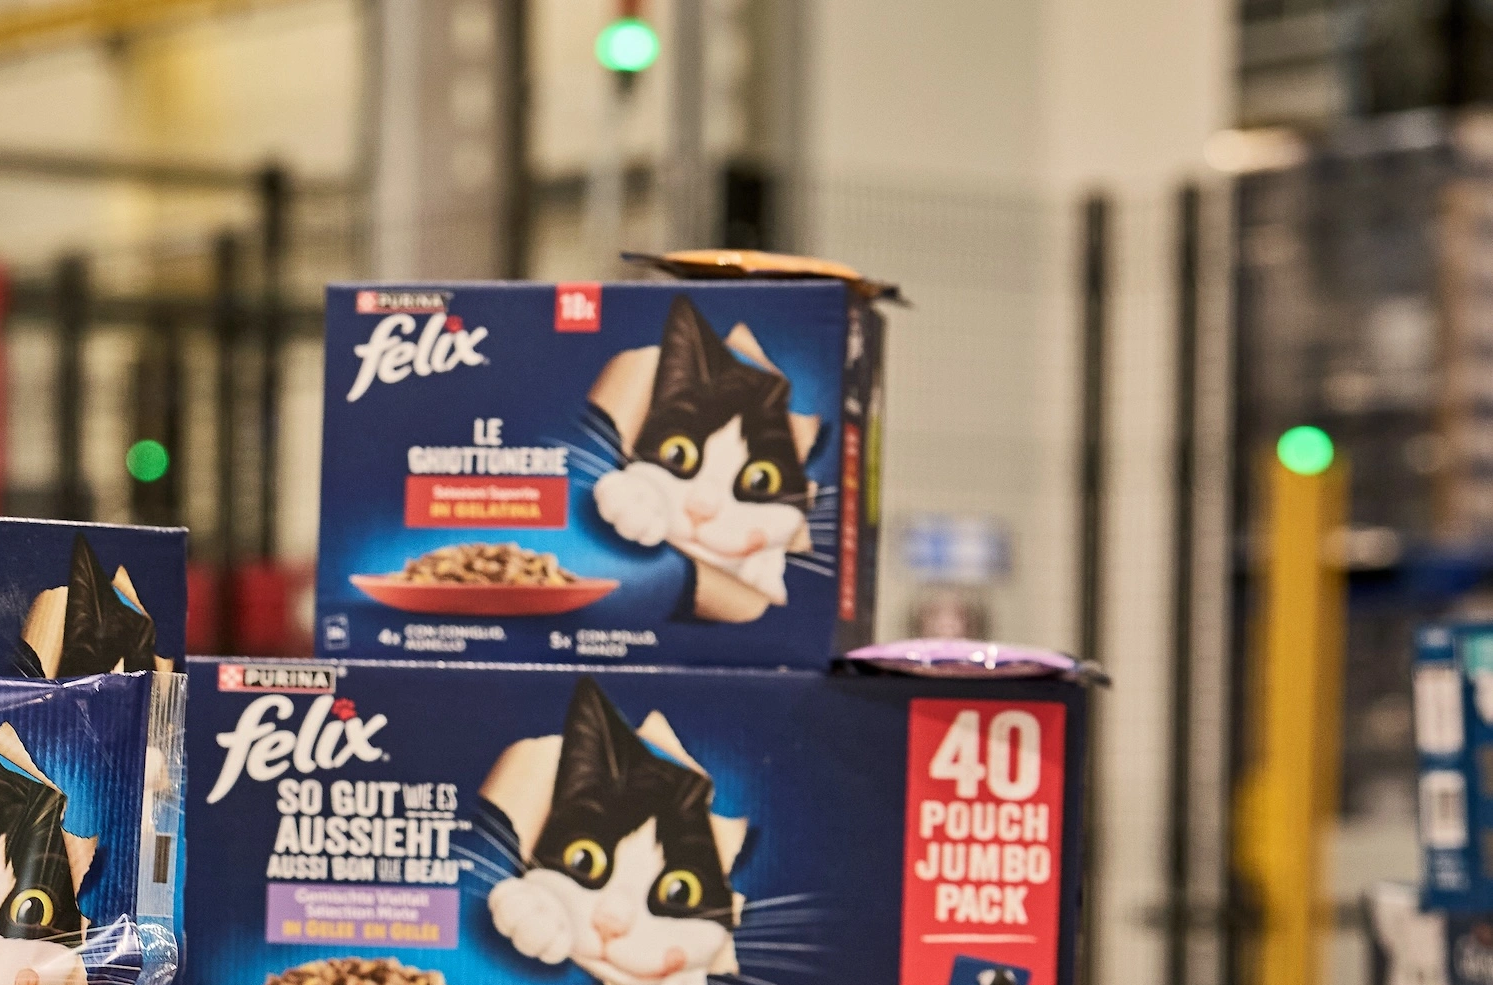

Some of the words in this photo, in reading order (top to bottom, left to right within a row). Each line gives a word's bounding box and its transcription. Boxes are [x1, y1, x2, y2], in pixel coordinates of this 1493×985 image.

[346, 312, 489, 402] felix
[473, 417, 504, 446] LE
[408, 446, 569, 475] GHIOTTONERIE
[244, 669, 329, 688] PURINA
[207, 694, 388, 804] felix
[929, 709, 1041, 800] 40
[277, 779, 323, 815] SO
[331, 780, 400, 817] GUT
[274, 815, 458, 858] AUSSIEHT
[920, 800, 1048, 842] POUCH
[267, 854, 327, 879] AUSSI
[331, 857, 375, 881] BON
[405, 860, 458, 884] BEAU
[915, 842, 1051, 885] JUMBO
[935, 883, 1028, 924] PACK
